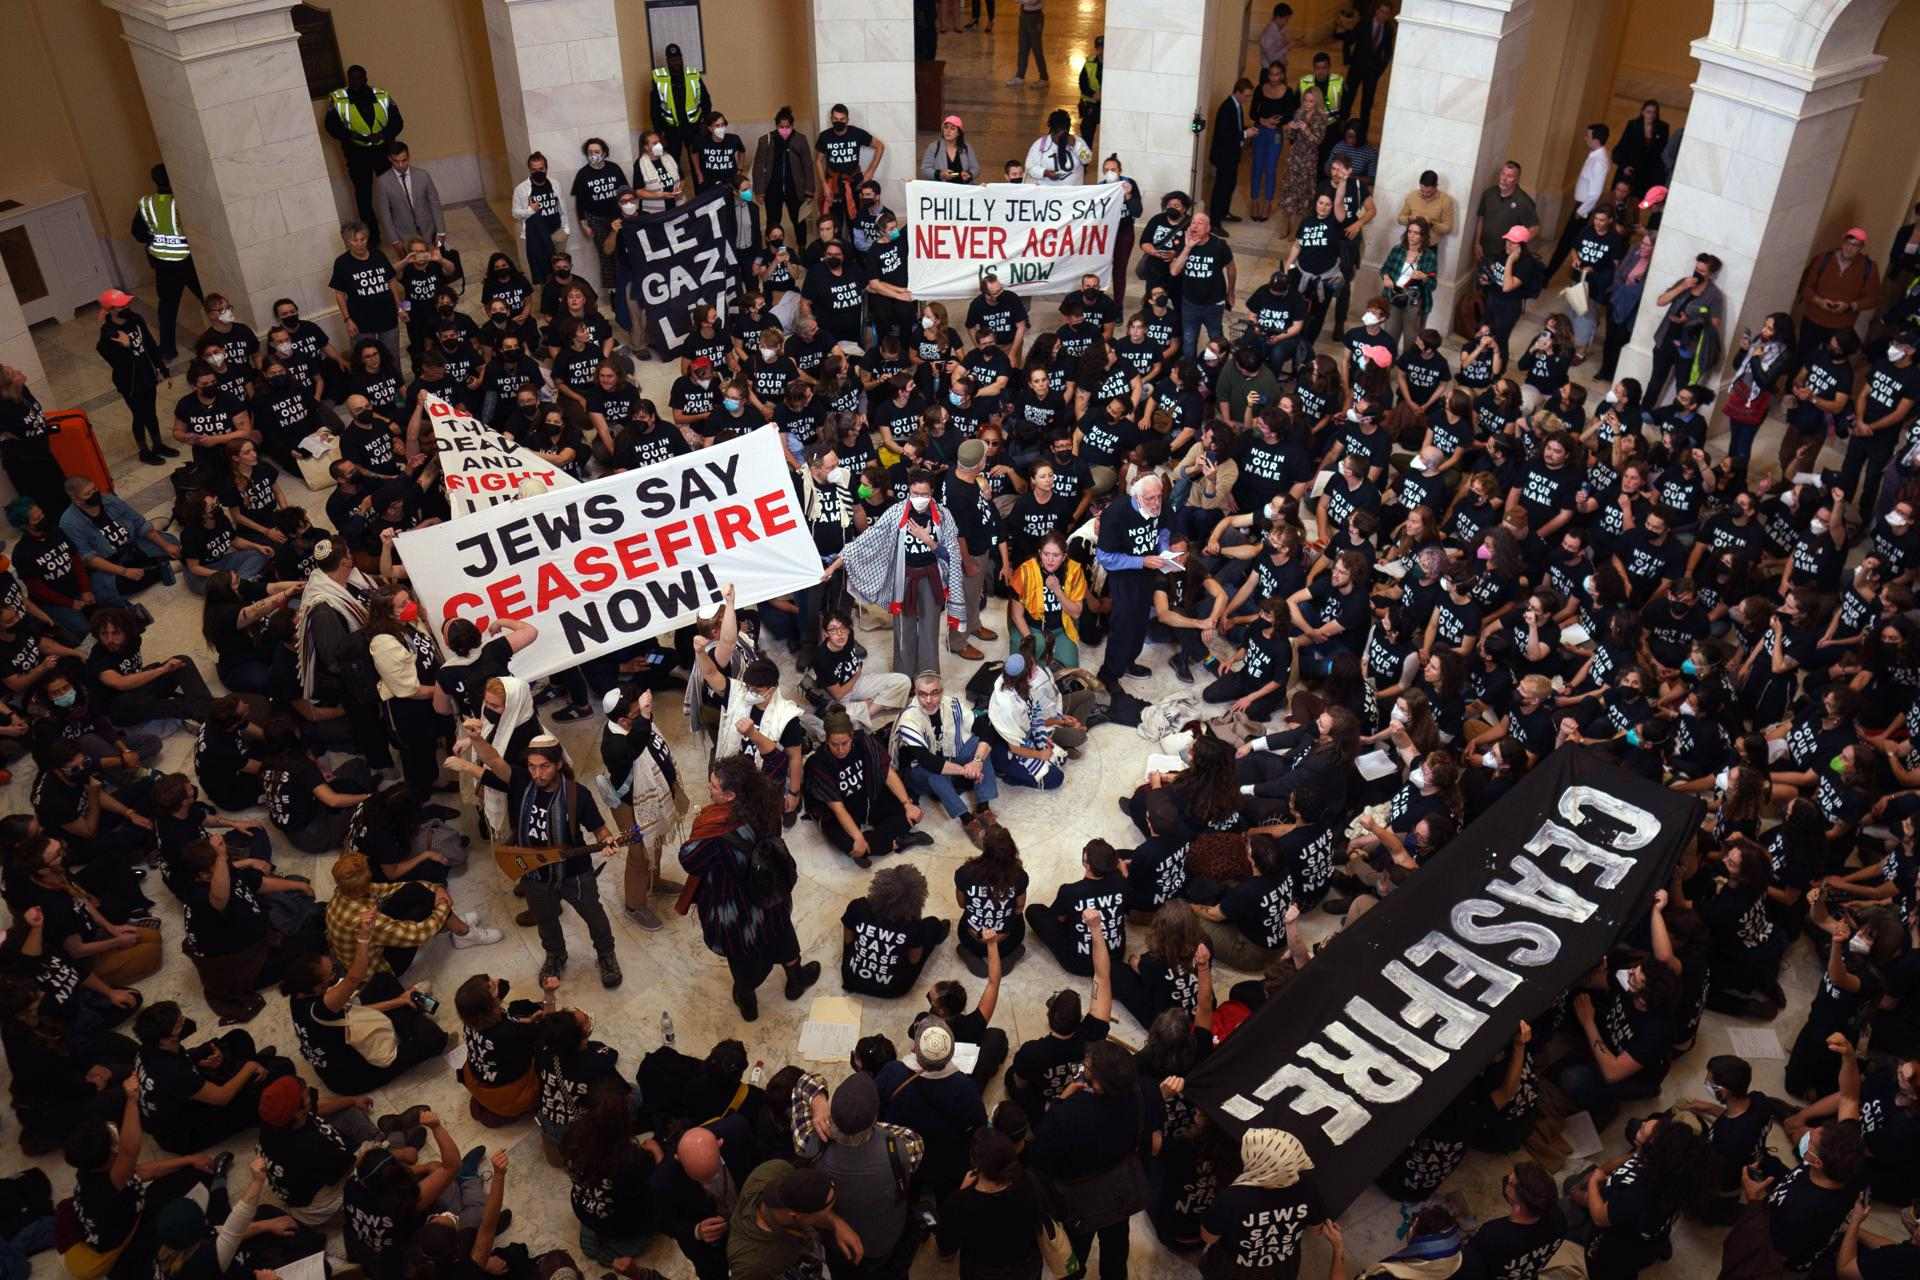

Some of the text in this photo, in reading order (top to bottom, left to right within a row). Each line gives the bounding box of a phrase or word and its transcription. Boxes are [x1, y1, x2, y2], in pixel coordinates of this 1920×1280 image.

[920, 197, 1111, 224] PHILLY JEWS SAY
[636, 196, 726, 264] LET
[916, 225, 1008, 259] NEVER
[1021, 225, 1108, 258] AGAIN
[979, 262, 1054, 284] IS NOW
[462, 455, 524, 473] AND
[455, 453, 739, 577] JEWS SAY
[443, 489, 797, 634] CEASEFIRE
[558, 564, 724, 655] NOW!
[1299, 829, 1333, 862] JEWS
[1074, 892, 1123, 911] JEWS
[1260, 875, 1293, 908] JEWS
[855, 921, 907, 945] JEWS
[858, 936, 897, 955] SAY
[849, 959, 893, 985] NOW
[1242, 1203, 1308, 1227] JEWS
[1250, 1221, 1298, 1240] SAY
[1236, 1248, 1296, 1267] NOW
